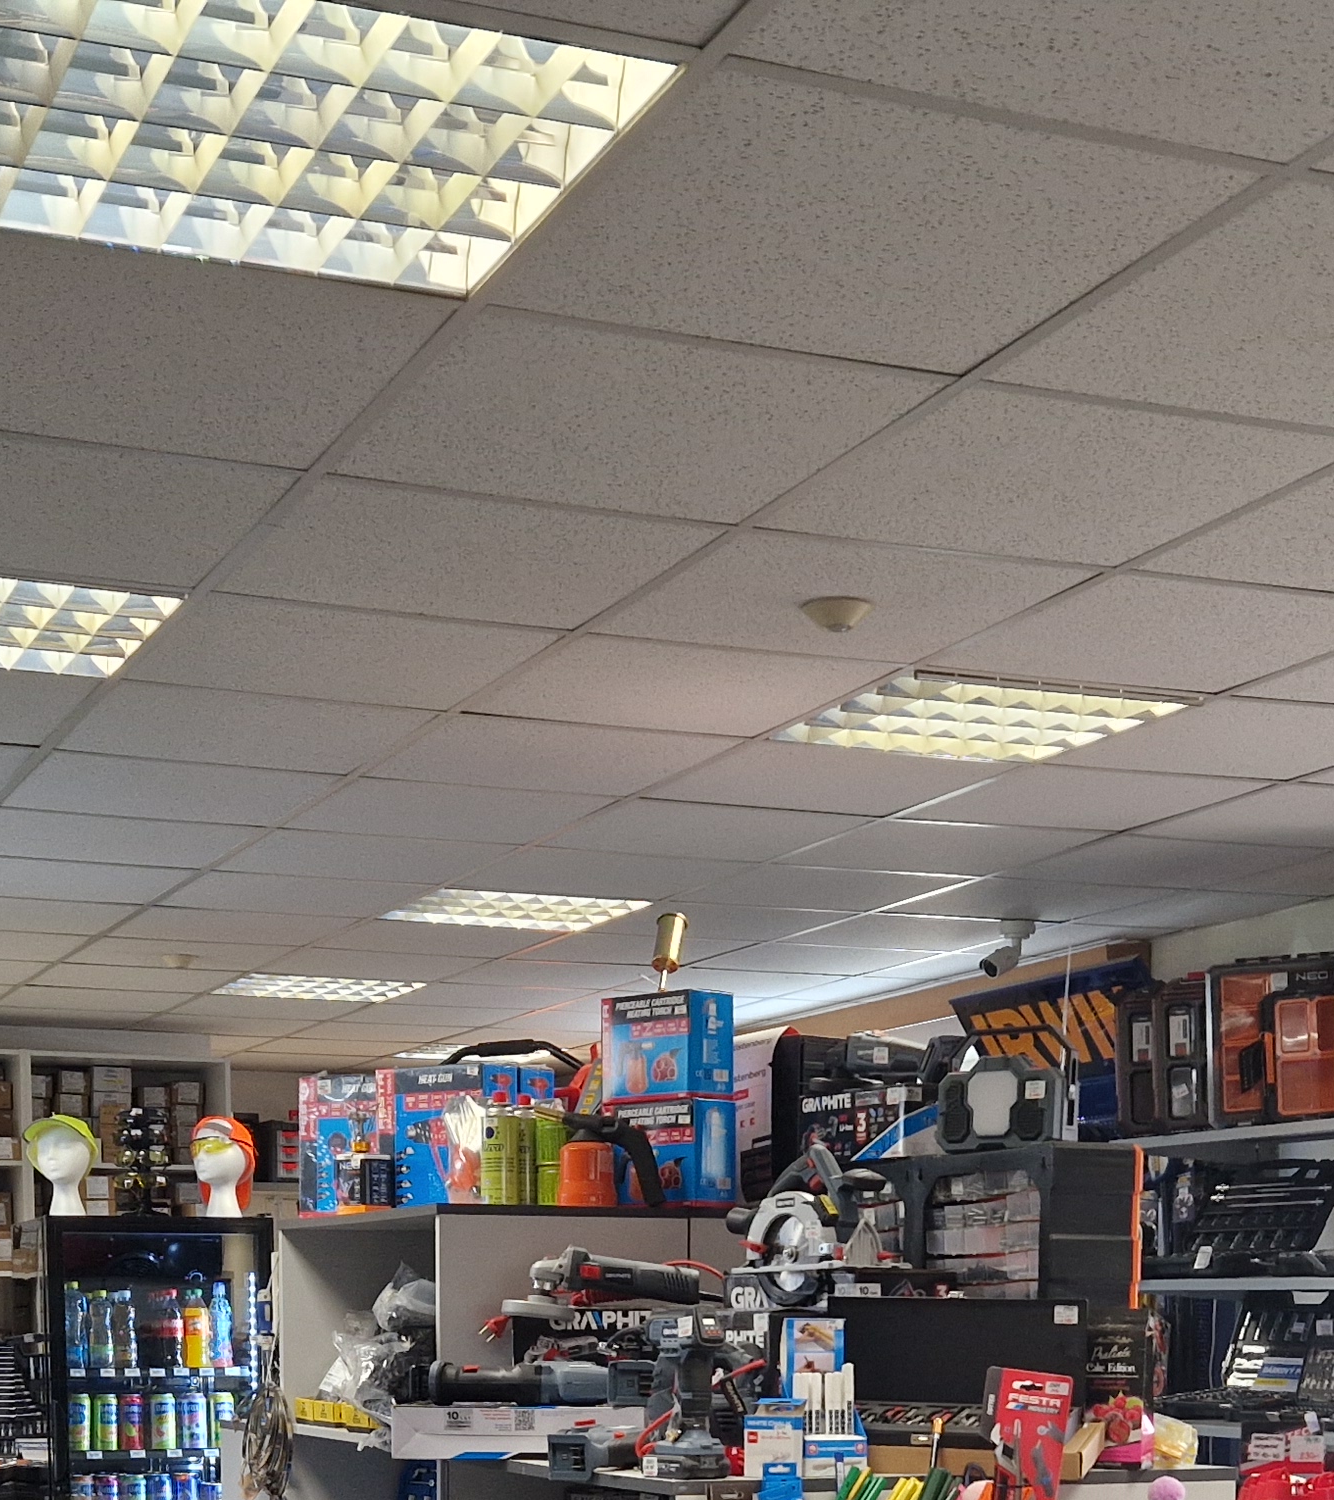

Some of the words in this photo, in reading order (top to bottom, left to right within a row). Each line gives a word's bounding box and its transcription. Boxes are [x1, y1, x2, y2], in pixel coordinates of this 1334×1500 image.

[1295, 971, 1329, 982] NEO
[801, 1093, 852, 1113] GRAPHITE
[856, 1112, 867, 1131] 3
[859, 1285, 869, 1295] 10
[1107, 1362, 1136, 1373] Edition
[1008, 1392, 1062, 1406] FESTA
